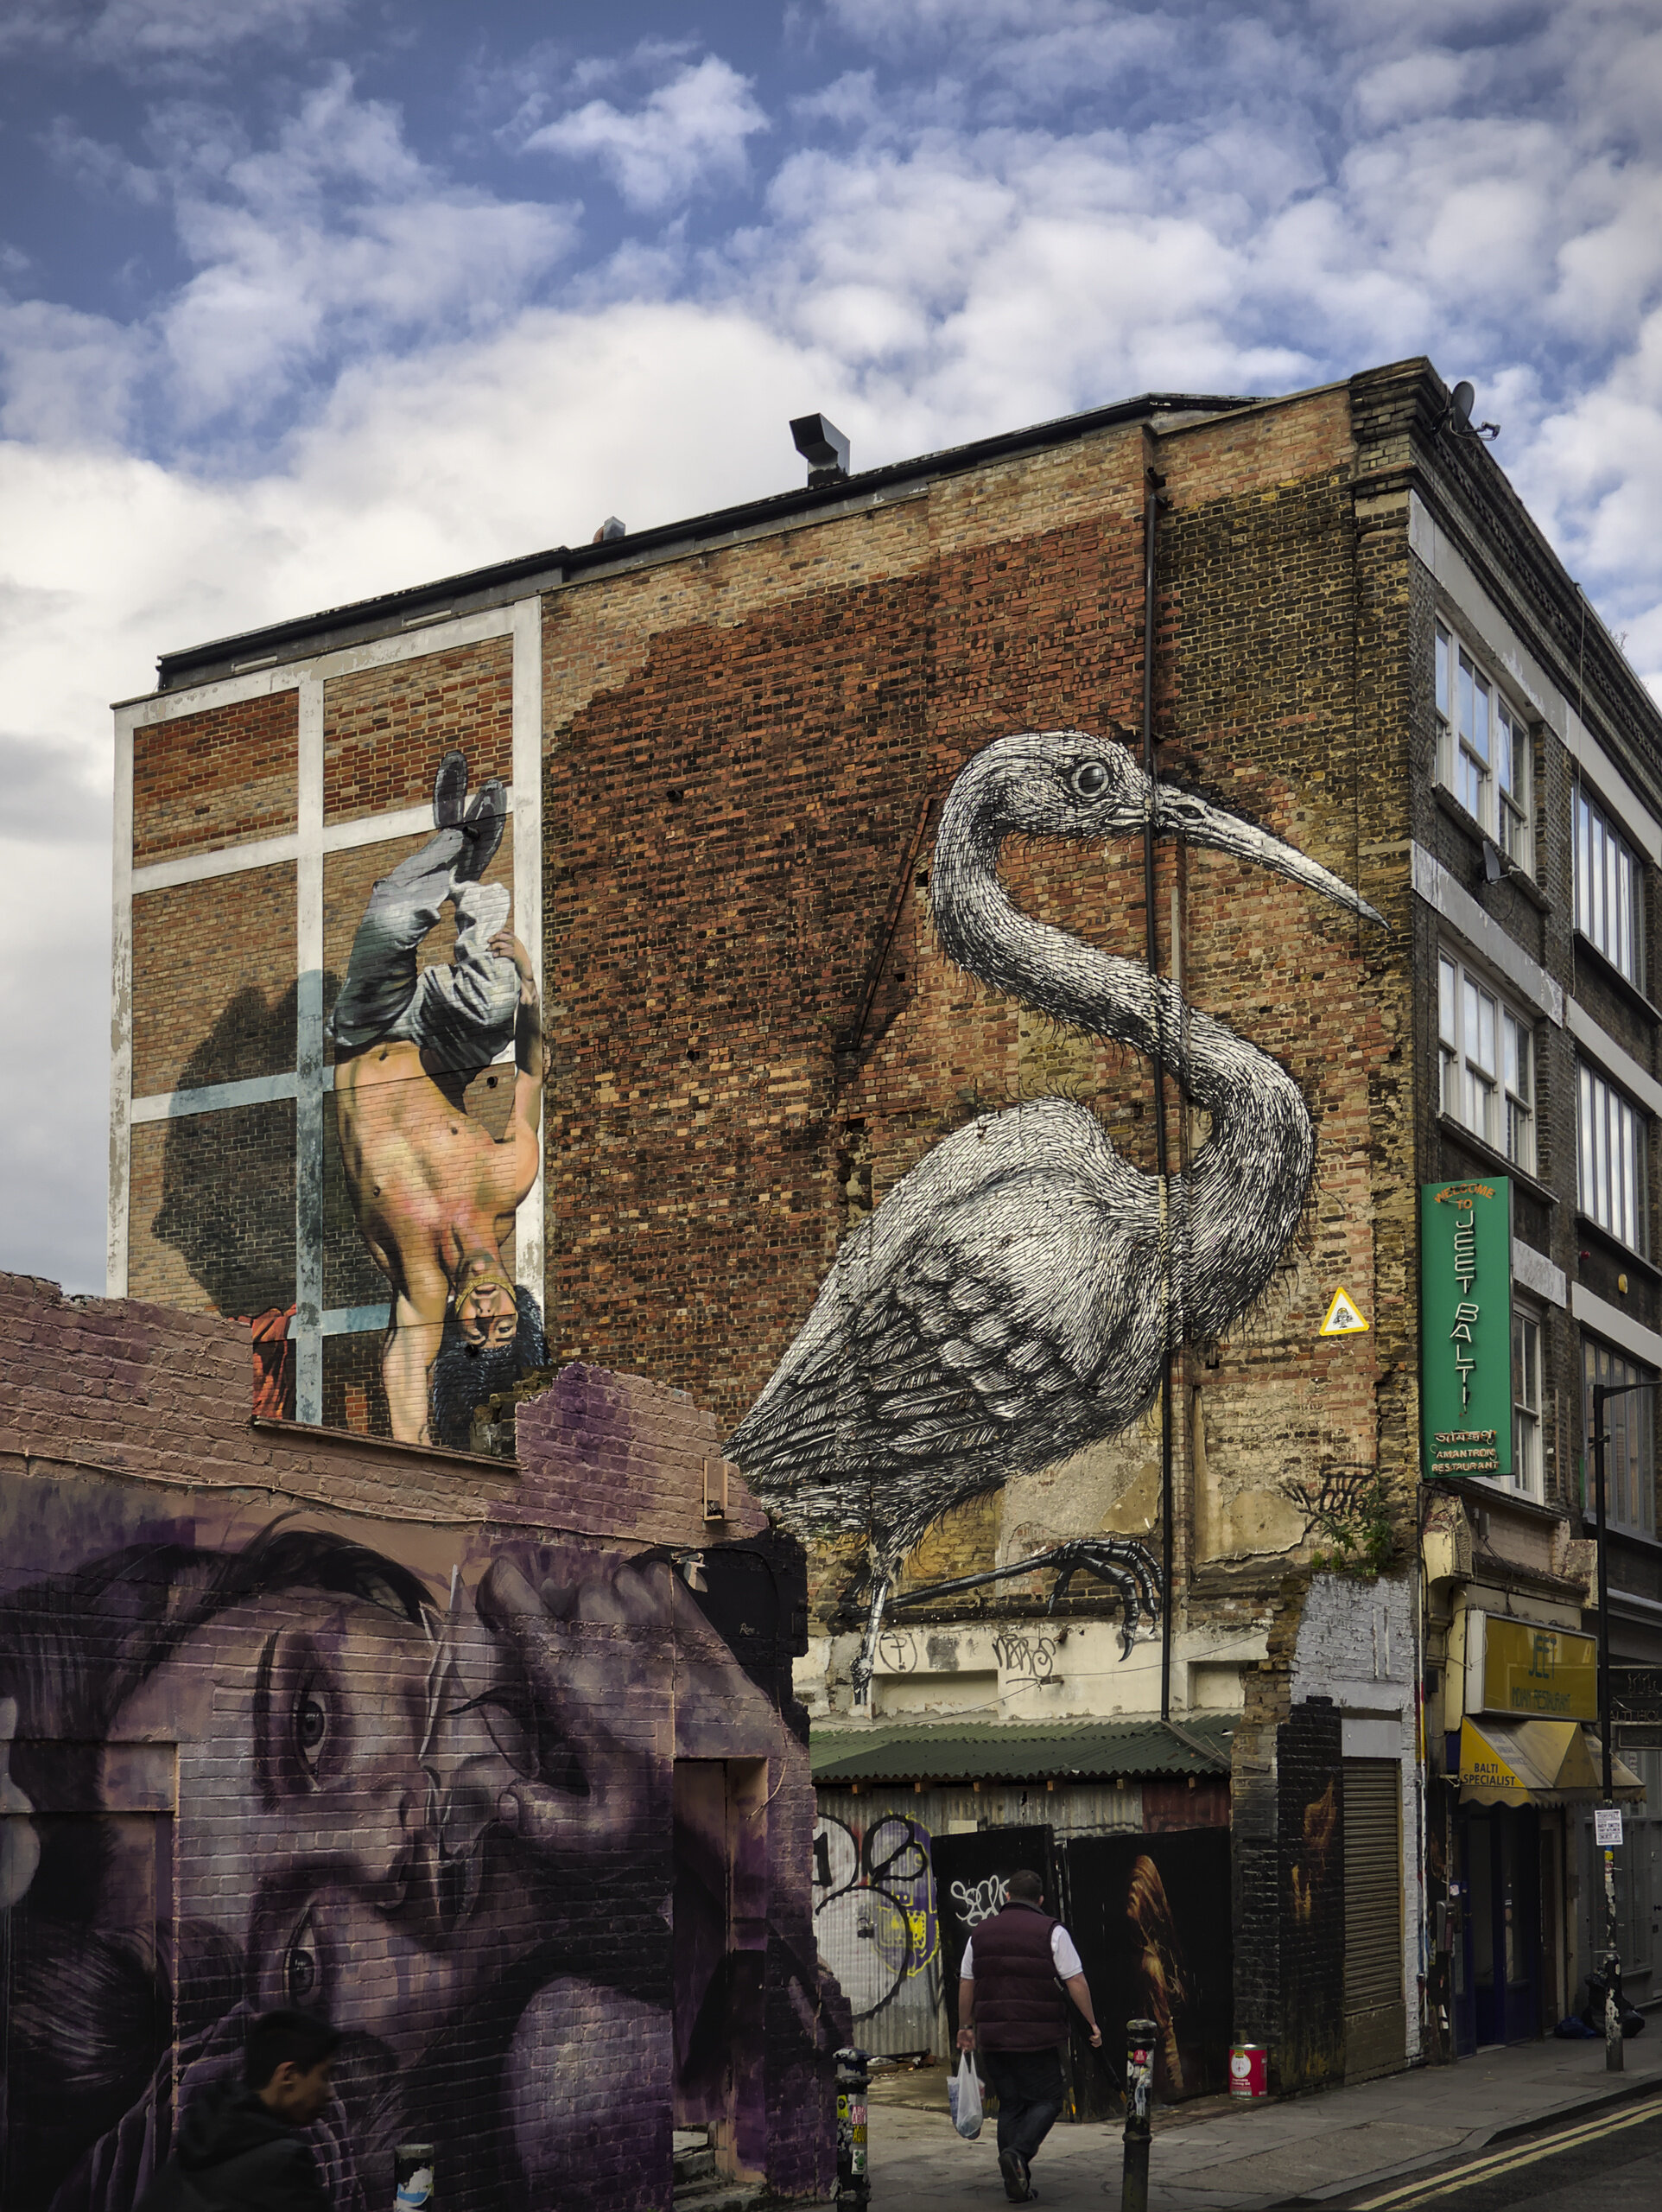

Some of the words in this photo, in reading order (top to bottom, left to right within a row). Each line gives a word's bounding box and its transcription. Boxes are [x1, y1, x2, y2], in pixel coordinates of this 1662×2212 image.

[1433, 1184, 1496, 1203] WELCOME
[1456, 1198, 1473, 1210] TO
[1454, 1210, 1476, 1294] JEET
[1449, 1302, 1480, 1408] BALTI
[1431, 1461, 1500, 1472] RESTAURANT
[1529, 1632, 1557, 1680] JEET
[1474, 1762, 1499, 1773] BALTI
[1462, 1773, 1516, 1786] SPECIALIST
